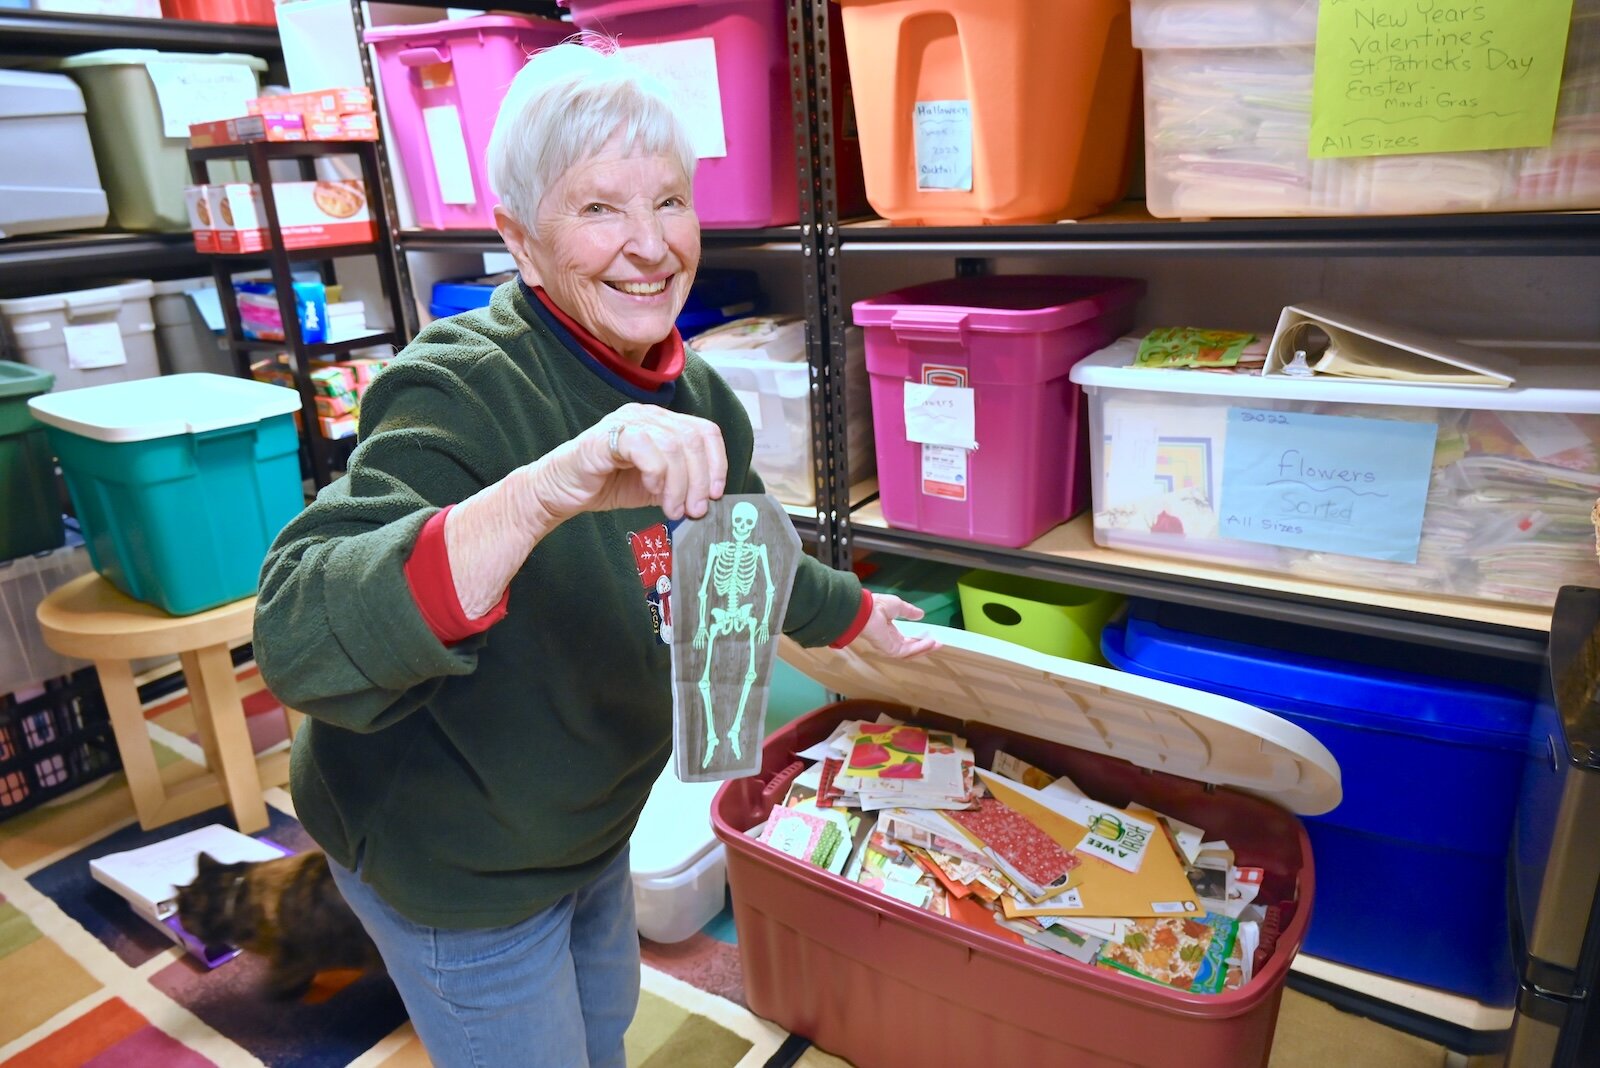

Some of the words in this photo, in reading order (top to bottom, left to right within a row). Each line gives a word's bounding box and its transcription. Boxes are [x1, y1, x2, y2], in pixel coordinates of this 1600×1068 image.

[1354, 7, 1408, 30] New
[1350, 27, 1494, 54] Valentines
[1487, 47, 1533, 79] Day
[1345, 76, 1420, 100] Easter
[1436, 92, 1479, 108] Gras
[1321, 135, 1352, 152] All
[1360, 134, 1419, 150] Sizes
[1241, 411, 1290, 425] 2022
[1279, 491, 1354, 521] Sorted
[1225, 513, 1253, 528] All
[1087, 837, 1115, 854] WEE
[1118, 823, 1151, 853] IRISH
[1118, 850, 1128, 858] A
